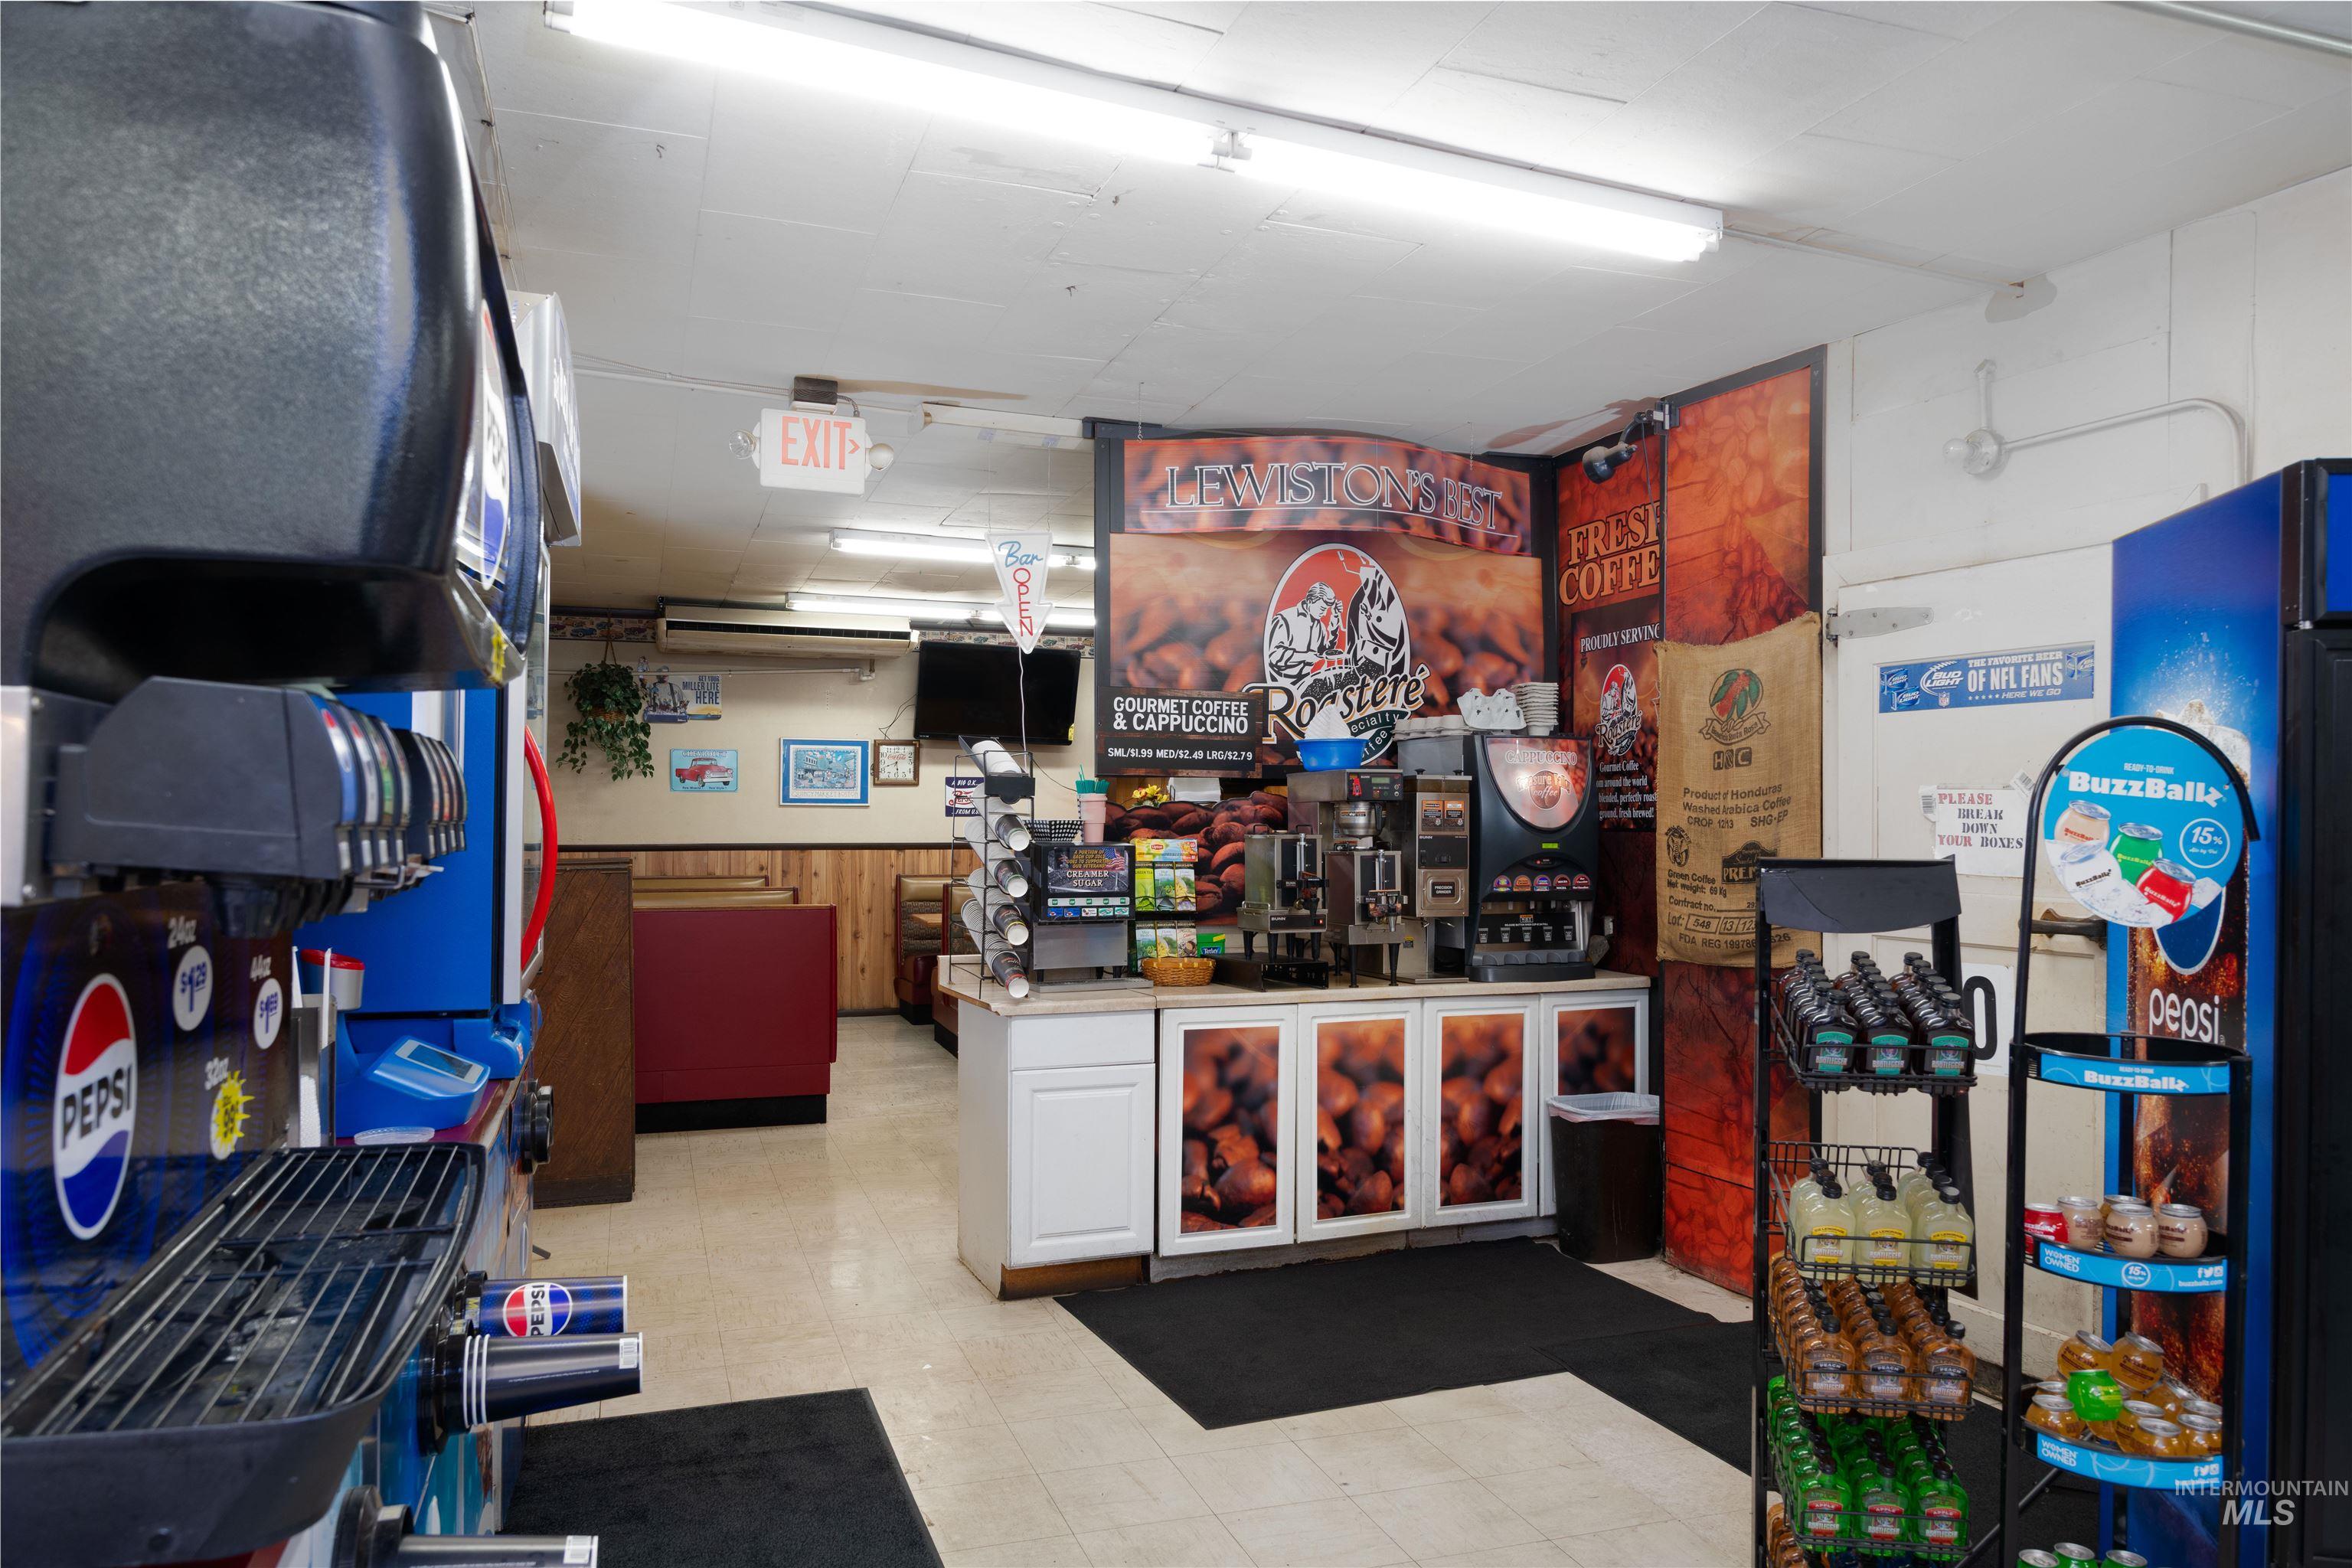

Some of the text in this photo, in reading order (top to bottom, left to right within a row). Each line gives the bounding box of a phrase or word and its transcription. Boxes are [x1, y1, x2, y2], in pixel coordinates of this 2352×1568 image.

[781, 416, 852, 470] EXIT
[1165, 462, 1502, 529] LEWISTON'S BEST
[998, 541, 1043, 567] Bar
[1559, 544, 1660, 606] COFFE
[1013, 567, 1034, 636] OPEN
[1580, 631, 1619, 653] PROUDLY
[1968, 652, 2063, 668] THE FAVORITE BEER
[1926, 677, 1965, 687] LIGHT
[1932, 670, 1962, 680] BUD
[1968, 662, 2063, 692] OF NFL FANS
[682, 681, 720, 691] MILLER LITE
[695, 691, 720, 705] HERE
[2002, 691, 2027, 699] HERE
[1113, 697, 1249, 717] GOURMET COFFEE
[1113, 713, 1248, 733] & CAPPUCCINO
[1351, 712, 1400, 733] ecialty
[1108, 747, 1253, 761] SML/$1.99 MED/$2.49 LRG/$2.79
[1505, 750, 1577, 765] CAPPUCCINO
[1600, 760, 1638, 773] Gourmet Coffee
[2124, 763, 2174, 775] READY-TO-DRINK
[1605, 777, 1622, 787] around
[1632, 776, 1648, 786] world
[2068, 770, 2223, 808] BuzzBallz
[1533, 786, 1558, 799] coffee
[1599, 792, 1658, 805] blended, perfectly roast
[1683, 784, 1782, 801] Product of Honduras
[1938, 793, 1993, 805] PLEASE
[1619, 808, 1632, 818] fresh
[1632, 807, 1654, 818] brewed!
[1683, 796, 1792, 815] Washed Arabica Coffee
[1687, 815, 1713, 828] CROP
[1958, 808, 2004, 820] BREAK
[1962, 822, 1998, 834] DOWN
[2191, 826, 2223, 844] 15%
[1938, 835, 2024, 849] YOUR BOXES
[1668, 869, 1716, 885] Green Coffee
[1667, 878, 1678, 887] Net
[1719, 887, 1727, 898] Kg
[1668, 896, 1703, 911] Contract
[1668, 912, 1684, 926] Lot:
[1693, 920, 1711, 929] 548
[1723, 920, 1733, 931] 13
[1679, 933, 1721, 949] FDA REG
[2149, 988, 2219, 1044] pepsi
[1815, 1056, 1848, 1065] BOOTLEGGER
[1872, 1060, 1905, 1068] BOOTLEGGER
[1932, 1060, 1965, 1069] BOOTLEGGER
[2084, 1070, 2187, 1092] BuzzBallz
[61, 1061, 134, 1149] PEPSI
[1811, 1248, 1844, 1257] BOOTLEGGER
[1869, 1250, 1903, 1259] BOOTLEGGER
[1930, 1253, 1963, 1263] BOOTLEGGER
[2044, 1248, 2079, 1264] WOMEN
[2044, 1256, 2080, 1272] OWNED
[531, 1285, 546, 1337] PEPSI
[1870, 1385, 1903, 1393] BOOTLEGGER
[1930, 1387, 1962, 1396] BOOTLEGGER
[2041, 1439, 2077, 1458] WOMEN
[2041, 1449, 2076, 1467] OWNED
[1808, 1521, 1839, 1530] BOOTLEGGER
[1868, 1526, 1900, 1535] BOOTLEGGER
[1926, 1529, 1958, 1538] BOOTLEGGER
